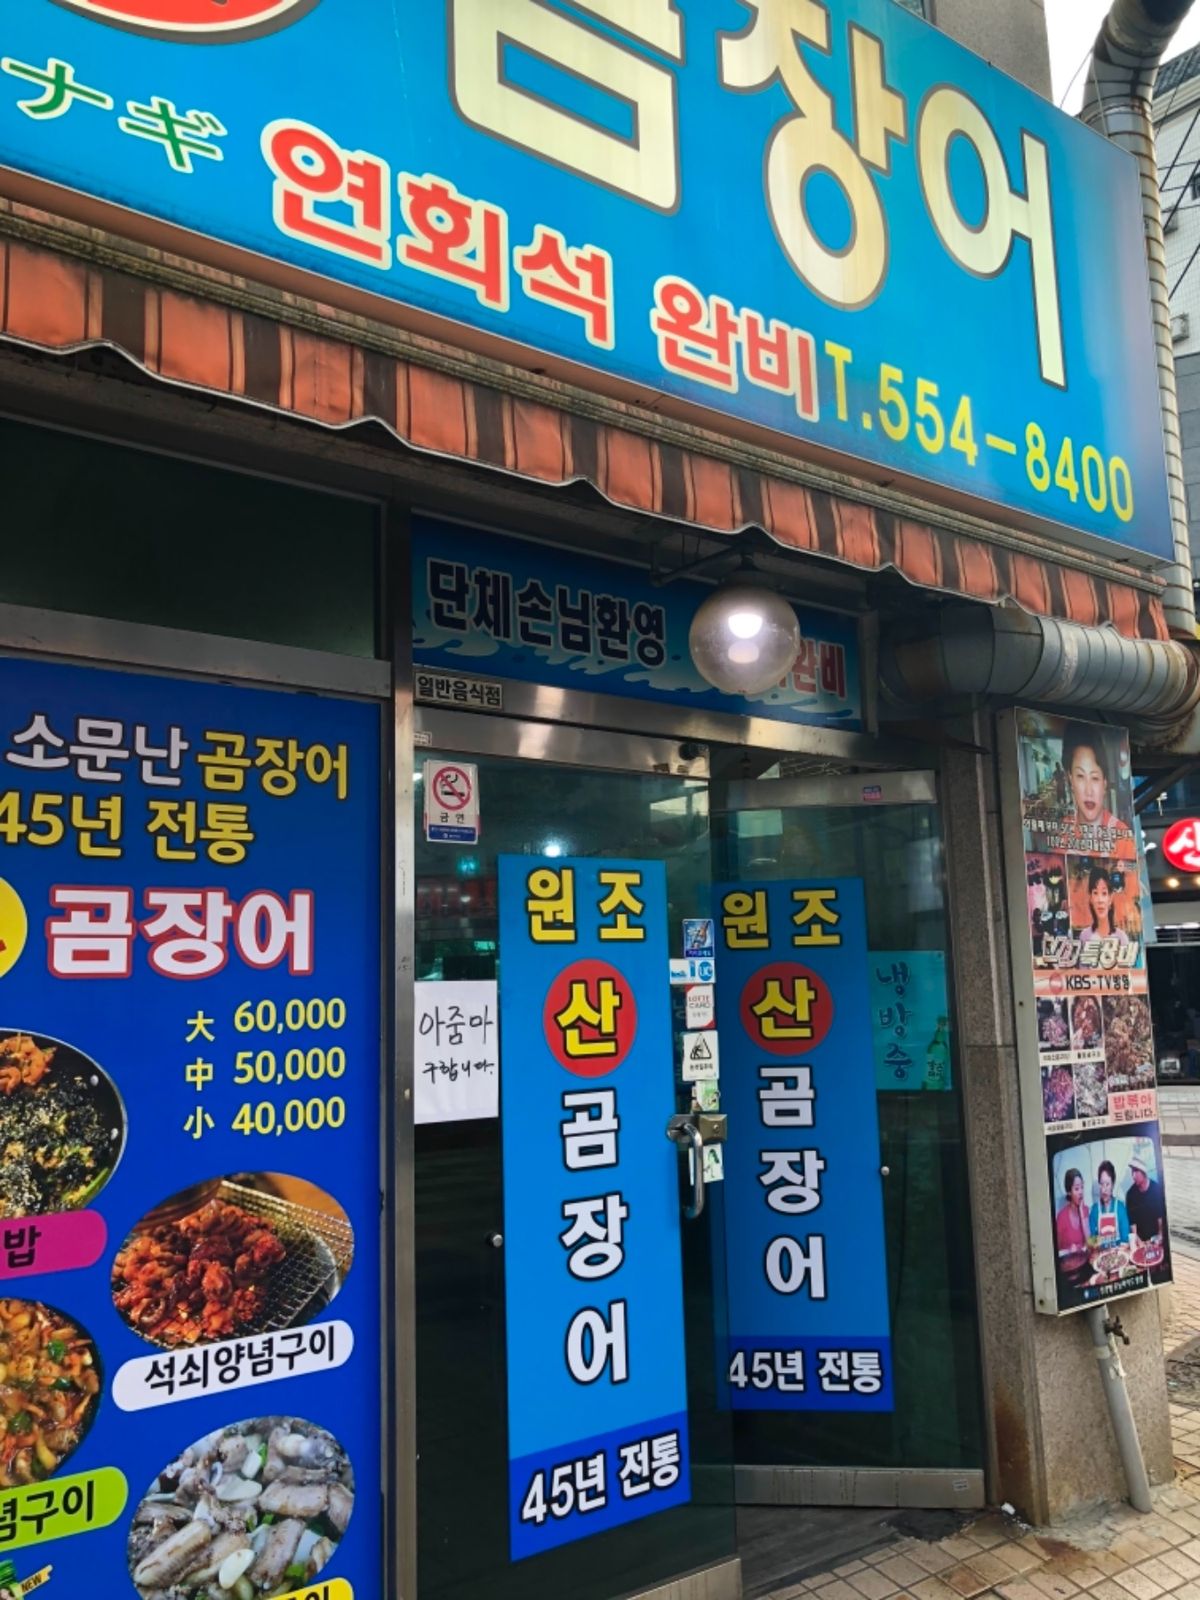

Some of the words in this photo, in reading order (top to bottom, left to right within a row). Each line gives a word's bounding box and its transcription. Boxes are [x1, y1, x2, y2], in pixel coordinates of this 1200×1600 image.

[261, 119, 616, 351] 연회석
[650, 275, 820, 423] 완비
[426, 559, 667, 668] 단체손님환영
[417, 675, 502, 706] 일반음식점
[6, 714, 190, 787] 소문난
[198, 731, 350, 800] 곰장어
[0, 791, 122, 858] 45년
[147, 800, 255, 864] 전통
[47, 885, 315, 980] 곰장어
[185, 1010, 216, 1044] 大
[233, 997, 347, 1034] 60,000
[419, 1005, 493, 1047] 아줌마
[185, 1057, 214, 1092] 中
[233, 1046, 347, 1086] 50,000
[183, 1105, 215, 1140] 小
[231, 1095, 346, 1137] 40,000
[4, 1225, 41, 1268] 밥
[144, 1326, 335, 1396] 석쇠양념구이
[729, 1351, 805, 1391] 45년
[818, 1351, 883, 1392] 전통
[521, 1454, 606, 1524] 45년
[619, 1433, 681, 1499] 전통
